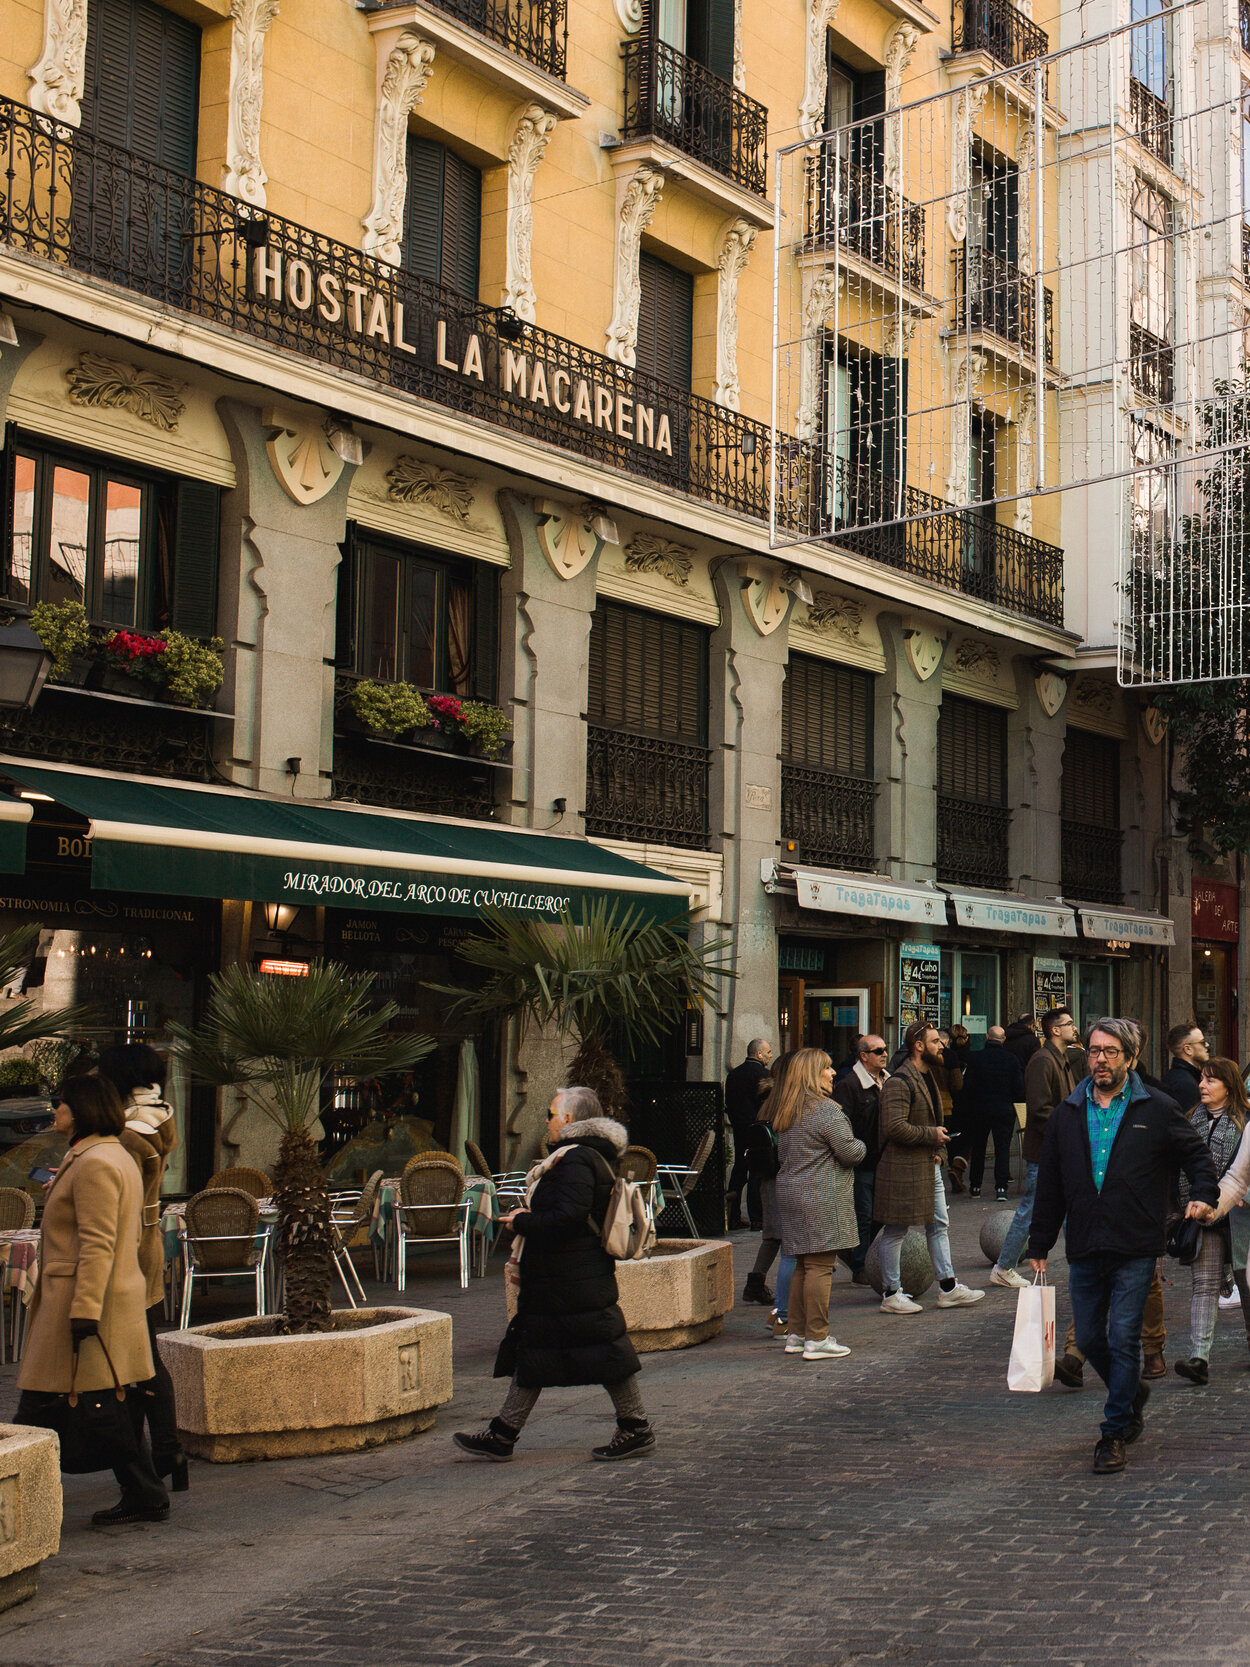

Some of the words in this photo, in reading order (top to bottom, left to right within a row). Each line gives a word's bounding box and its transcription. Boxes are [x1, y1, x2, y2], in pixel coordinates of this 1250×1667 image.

[256, 246, 417, 355] HOSTAL
[436, 320, 485, 382] LA
[503, 348, 673, 457] MACARENA
[57, 836, 93, 858] BOD
[283, 871, 369, 899] MIRADOR
[368, 880, 403, 900] DEL
[403, 883, 446, 905] ARCO
[448, 887, 472, 905] DE
[473, 888, 571, 915] CUCHILLEROS
[836, 886, 911, 912] TragaTapas
[0, 897, 70, 914] STRONOMIA
[123, 906, 195, 922] TRADICIONAL
[985, 905, 1047, 926] TragaTapas
[341, 930, 380, 942] BELLOTA
[346, 920, 377, 930] JAMON
